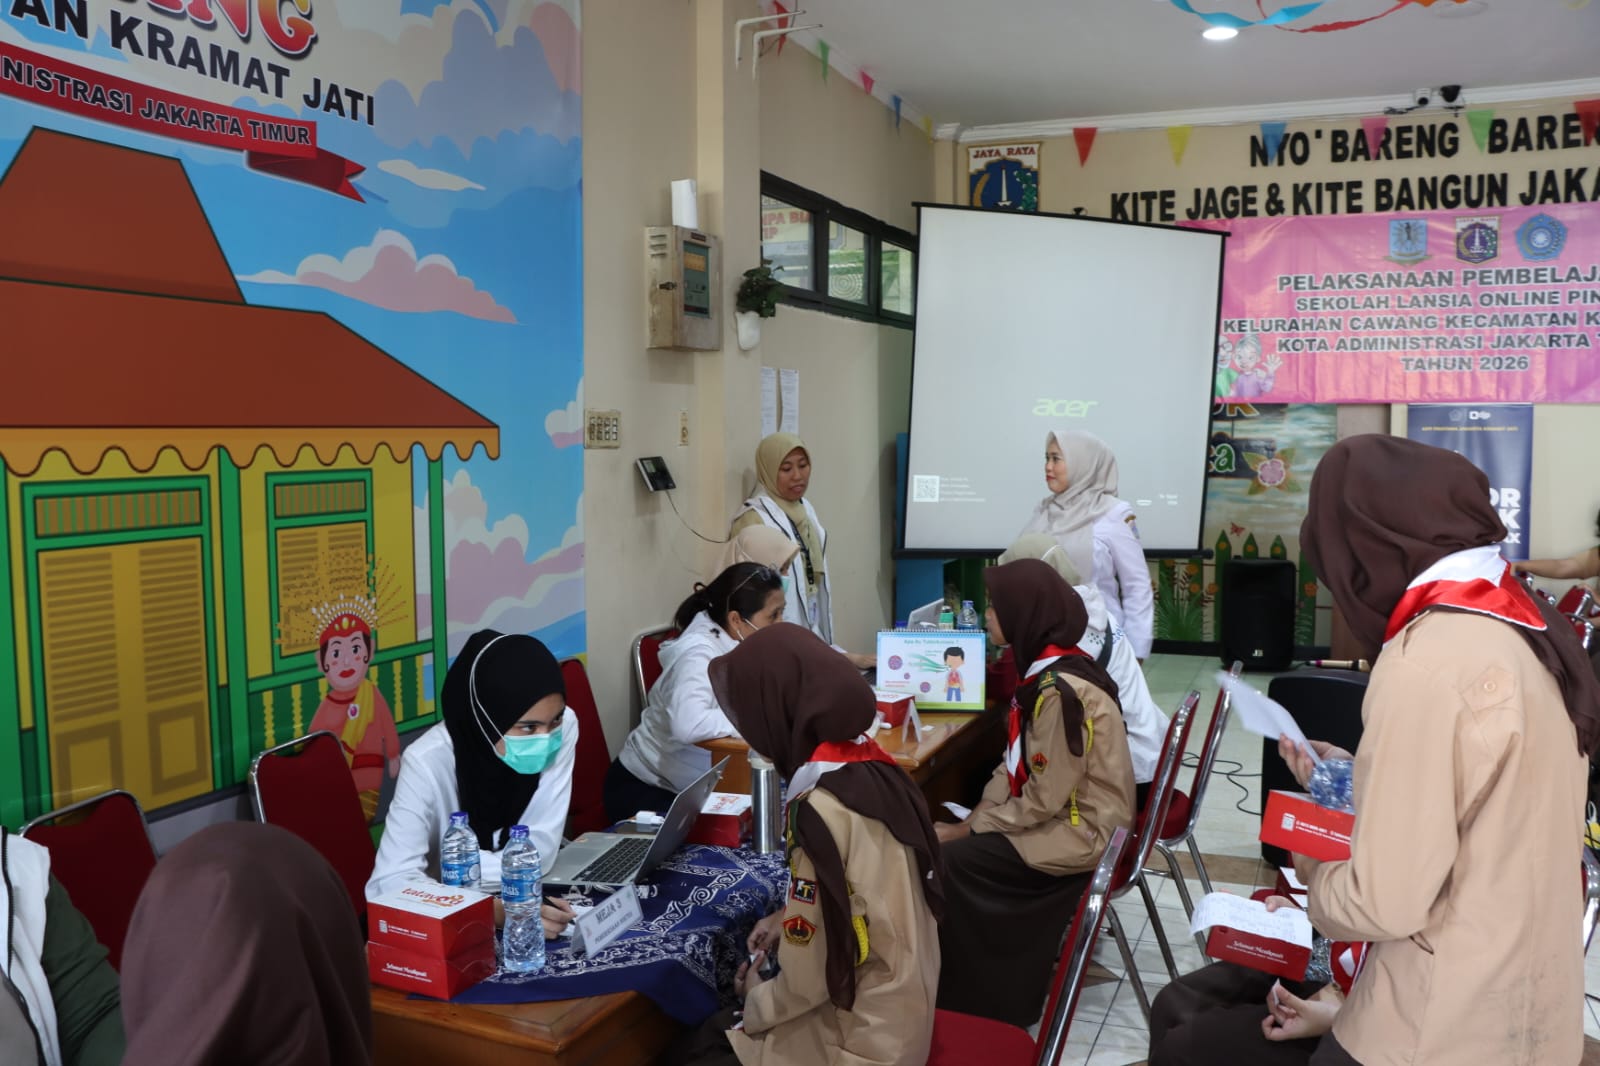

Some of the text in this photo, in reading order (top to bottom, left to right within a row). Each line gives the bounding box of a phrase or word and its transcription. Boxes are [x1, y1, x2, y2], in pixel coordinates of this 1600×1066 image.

[110, 9, 289, 98] KRAMAT
[303, 78, 375, 125] JATI
[1, 56, 311, 145] NISTRASI JAKARTA TIMUR
[973, 146, 1036, 159] JAYA RAYA
[1330, 122, 1459, 163] BARENG
[1112, 190, 1175, 219] KITE
[1186, 186, 1257, 219] JAGE
[1265, 183, 1284, 216] &
[1292, 180, 1363, 216] KITE
[1375, 173, 1508, 212] BANGUN
[1278, 265, 1600, 292] PELAKSANAAN PEMBELAJ
[1296, 295, 1390, 312] SEKOLAH
[1396, 294, 1473, 310] LANSIA
[1480, 291, 1561, 308] ONLINE
[1223, 318, 1341, 334] KELURAHAN
[1349, 315, 1438, 332] CAWANG
[1445, 312, 1577, 329] KECAMATAN
[1277, 333, 1590, 353] KOTA ADMINISTRASI JAKARTA
[1401, 355, 1529, 372] TAHUN 2026
[1032, 398, 1098, 418] acer
